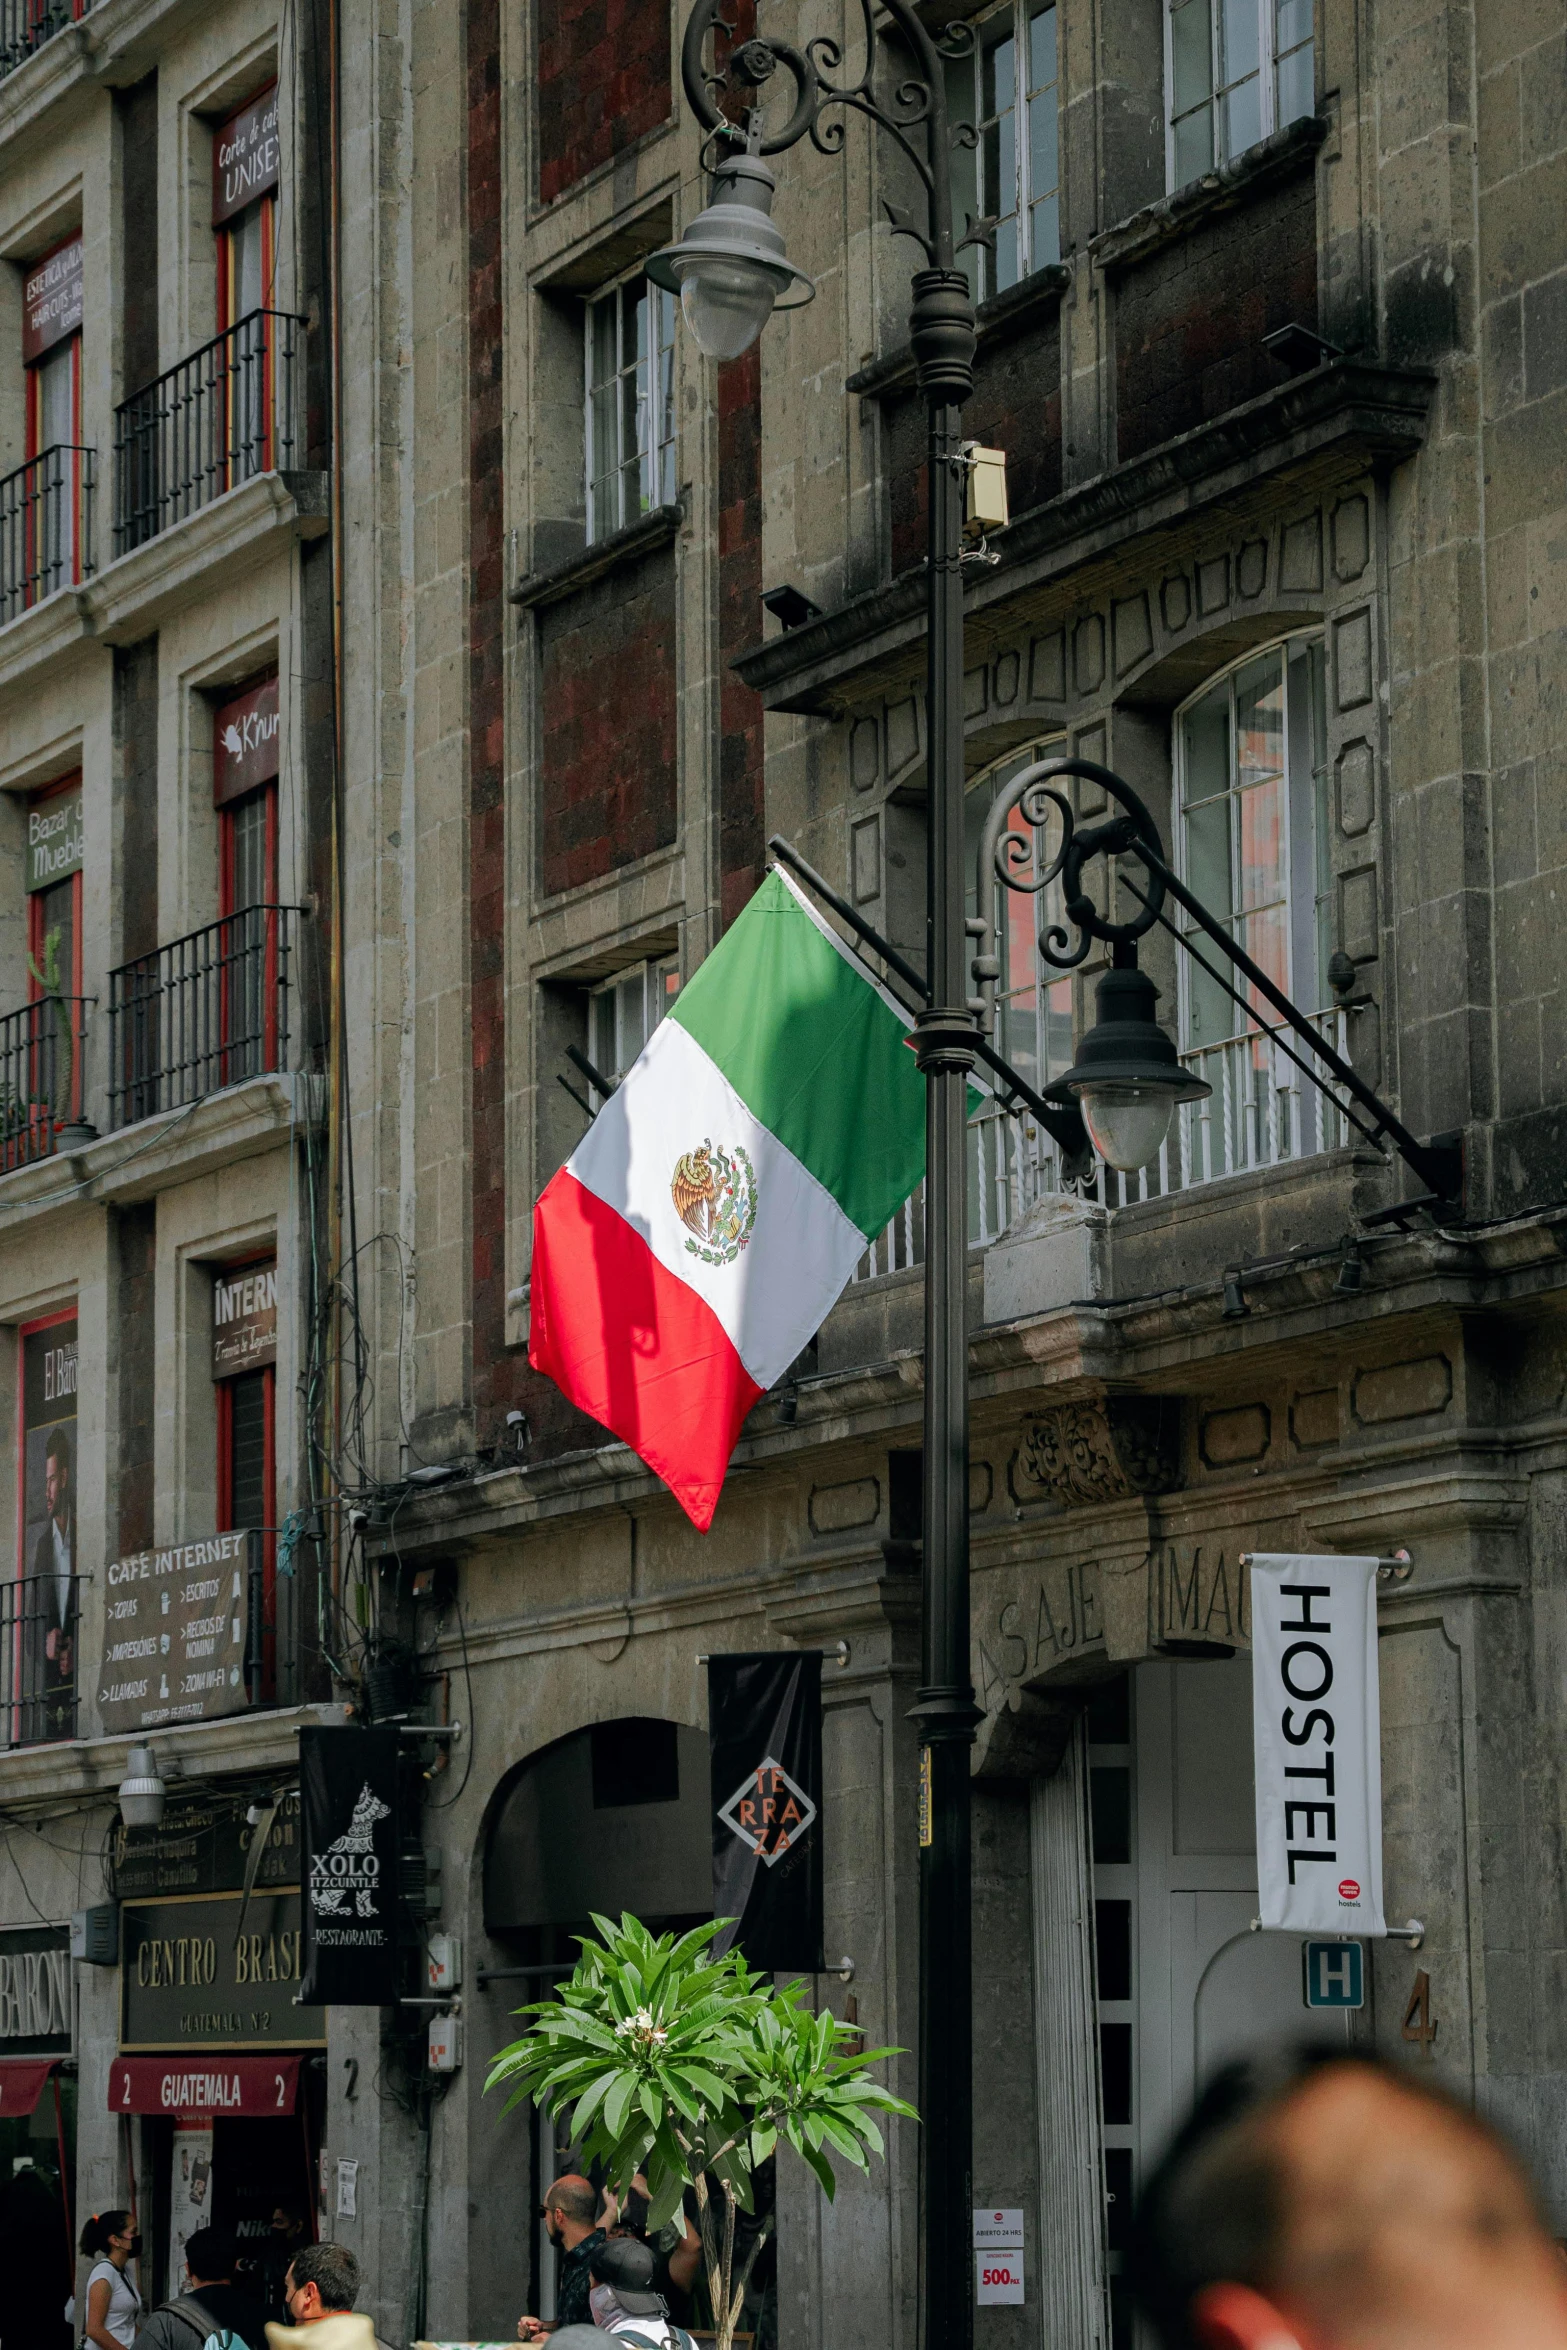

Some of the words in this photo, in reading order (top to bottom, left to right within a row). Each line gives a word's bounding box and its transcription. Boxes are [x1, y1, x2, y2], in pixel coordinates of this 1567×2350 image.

[219, 134, 246, 168] Corte
[29, 805, 73, 846] Bazar
[108, 1551, 150, 1586] CAFÉ
[155, 1534, 245, 1575] INTERNET
[186, 1578, 220, 1603] ESCRITOS
[114, 1599, 138, 1620] COPIAS
[187, 1617, 215, 1639] RECIBOS
[215, 1614, 226, 1633] DE
[977, 1560, 1104, 1714] ASAJE
[110, 1679, 148, 1702] LLAMADAS
[1279, 1584, 1337, 1886] HOSTEL
[754, 1766, 785, 1795] TE
[740, 1797, 803, 1827] RRA
[753, 1828, 791, 1855] ZA
[310, 1855, 380, 1877] XOLO
[310, 1877, 380, 1888] ITZCUINTLE
[1338, 1899, 1361, 1908] hostels
[138, 1937, 216, 1988] CENTRO
[1319, 1951, 1352, 1998] H
[180, 2013, 242, 2032] GUATEMALA
[1402, 1968, 1438, 2058] 4
[122, 2074, 131, 2105] 2
[161, 2074, 241, 2107] GUATEMALA
[275, 2075, 285, 2107] 2
[343, 2058, 358, 2102] 2
[982, 2268, 1010, 2285] 500
